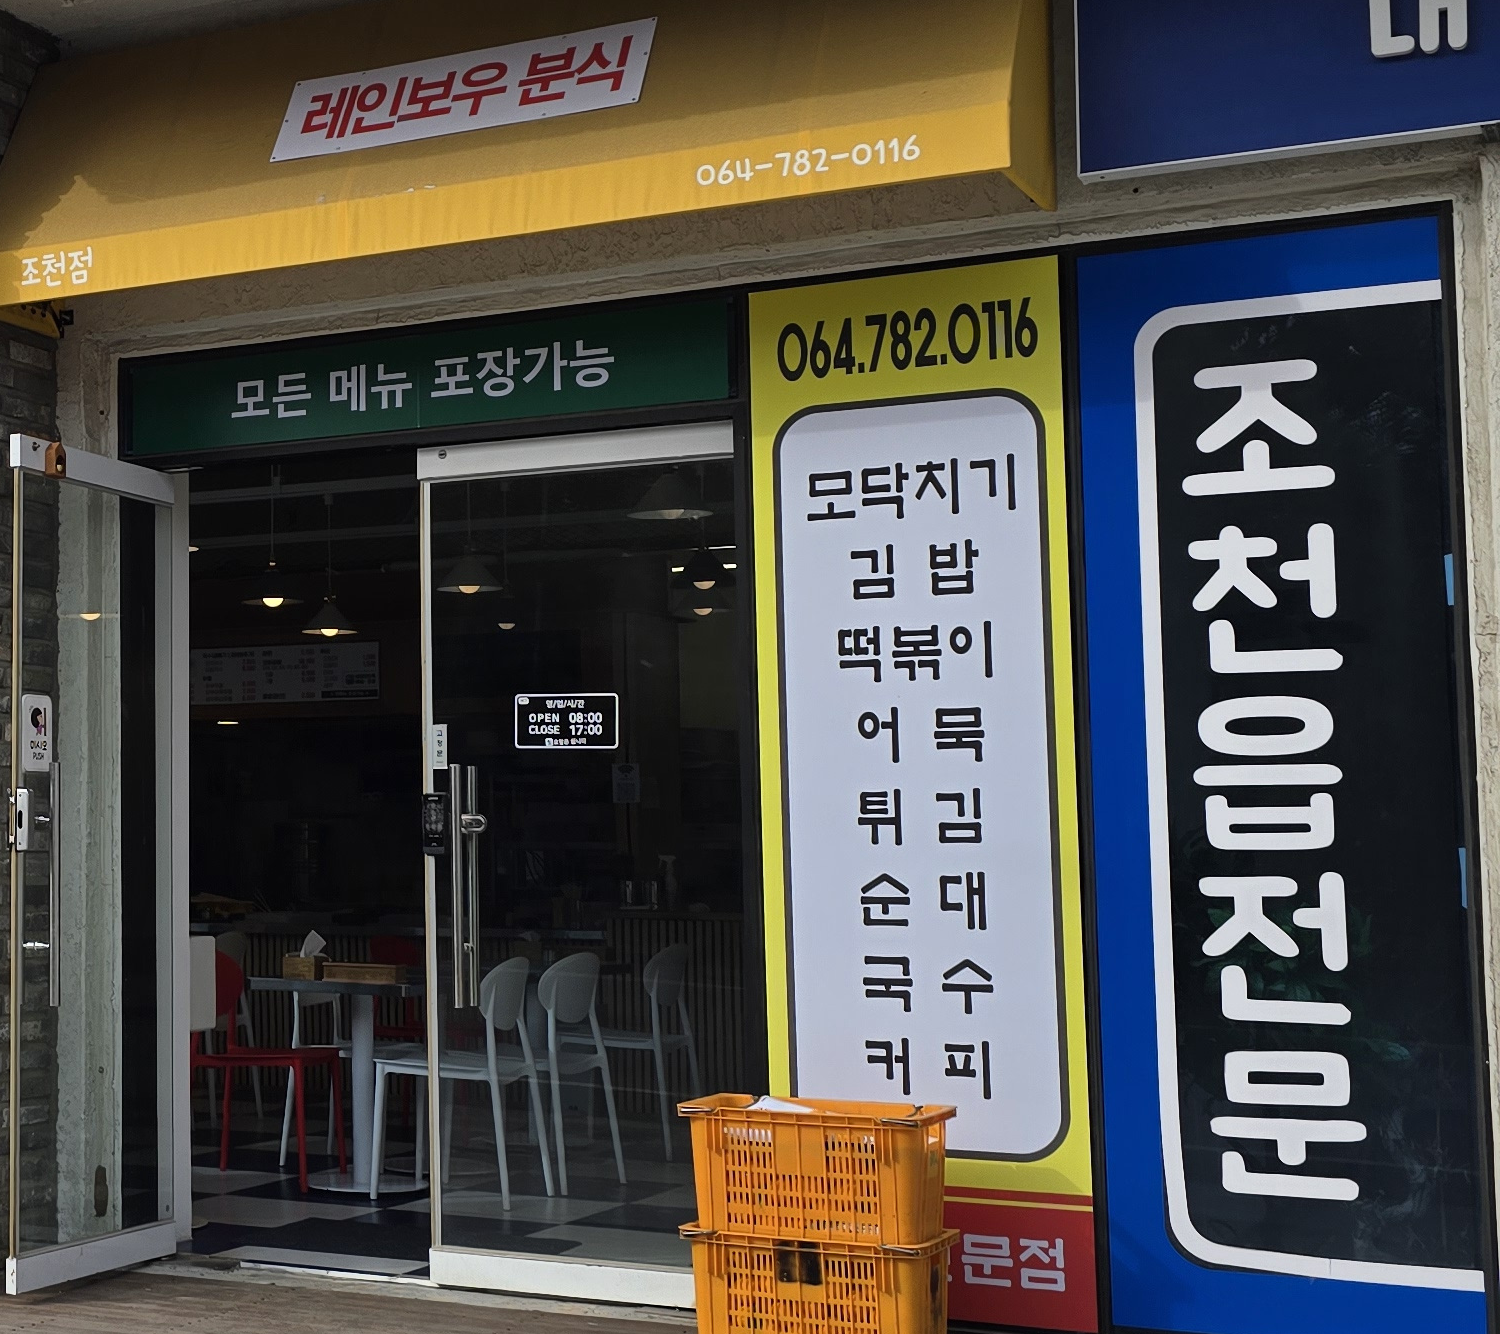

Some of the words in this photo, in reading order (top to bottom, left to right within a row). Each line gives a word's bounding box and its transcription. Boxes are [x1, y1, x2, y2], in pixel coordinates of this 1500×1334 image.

[301, 61, 509, 139] 레인보우
[518, 35, 634, 107] 분식
[696, 134, 921, 186] 064-782-0116
[21, 246, 94, 288] 조천점
[777, 297, 1038, 381] 064.782.0116
[231, 372, 311, 419] 모든
[329, 363, 412, 412] 메뉴
[431, 340, 615, 399] 포장가능
[807, 453, 1016, 521] 모닥치기
[838, 621, 993, 682] 떡볶이
[528, 725, 560, 735] CLOSE
[569, 724, 603, 735] 17:00
[529, 713, 560, 723] OPEN
[569, 712, 603, 723] 08:00
[33, 752, 44, 760] PUSH
[1181, 358, 1368, 1202] 조천읍전문
[947, 1233, 1066, 1292] 문점
